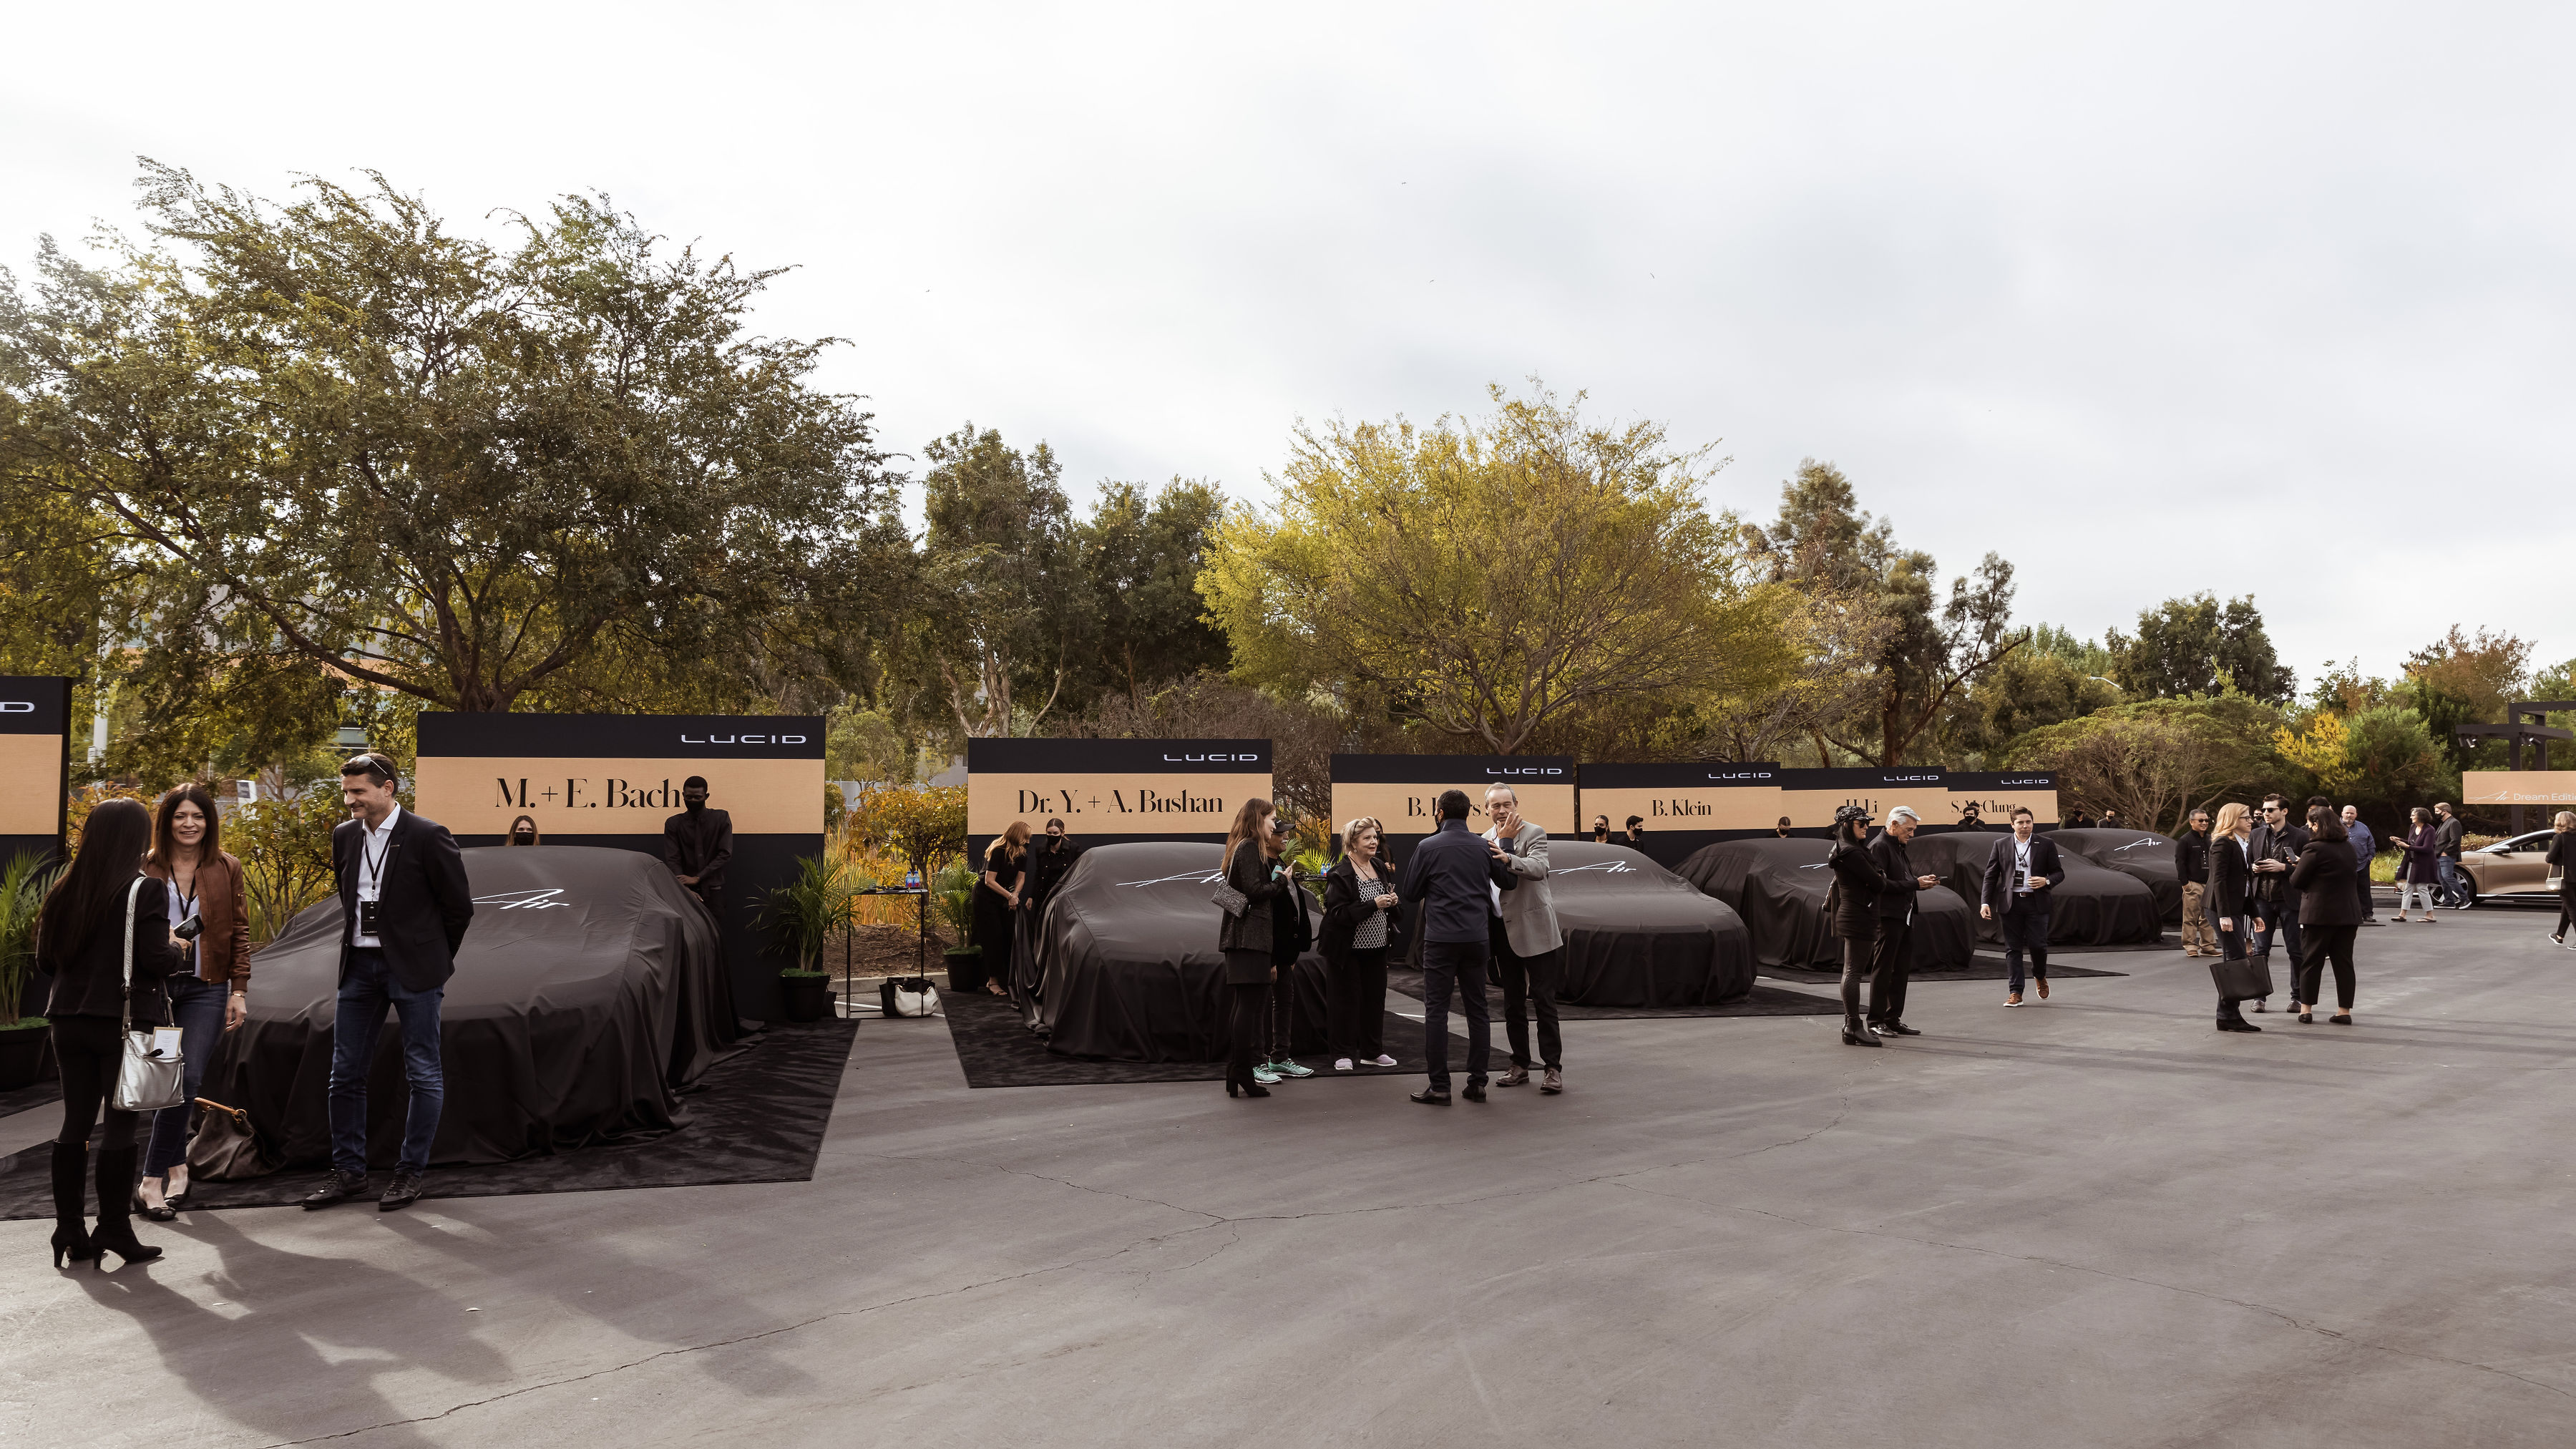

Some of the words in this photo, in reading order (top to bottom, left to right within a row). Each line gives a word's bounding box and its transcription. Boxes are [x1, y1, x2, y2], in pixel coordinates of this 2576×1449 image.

[681, 734, 806, 744] LUCID
[495, 778, 536, 809] M.
[566, 779, 597, 809] E.
[606, 778, 680, 809] Bach
[1018, 789, 1053, 814] Dr.
[1059, 789, 1081, 814] Y.
[1107, 789, 1133, 814] A.
[1139, 789, 1223, 814] Bushan
[1407, 796, 1427, 817] B.
[1652, 799, 1668, 816] B.
[1672, 799, 1712, 816] Klein
[1951, 800, 1962, 814] S.
